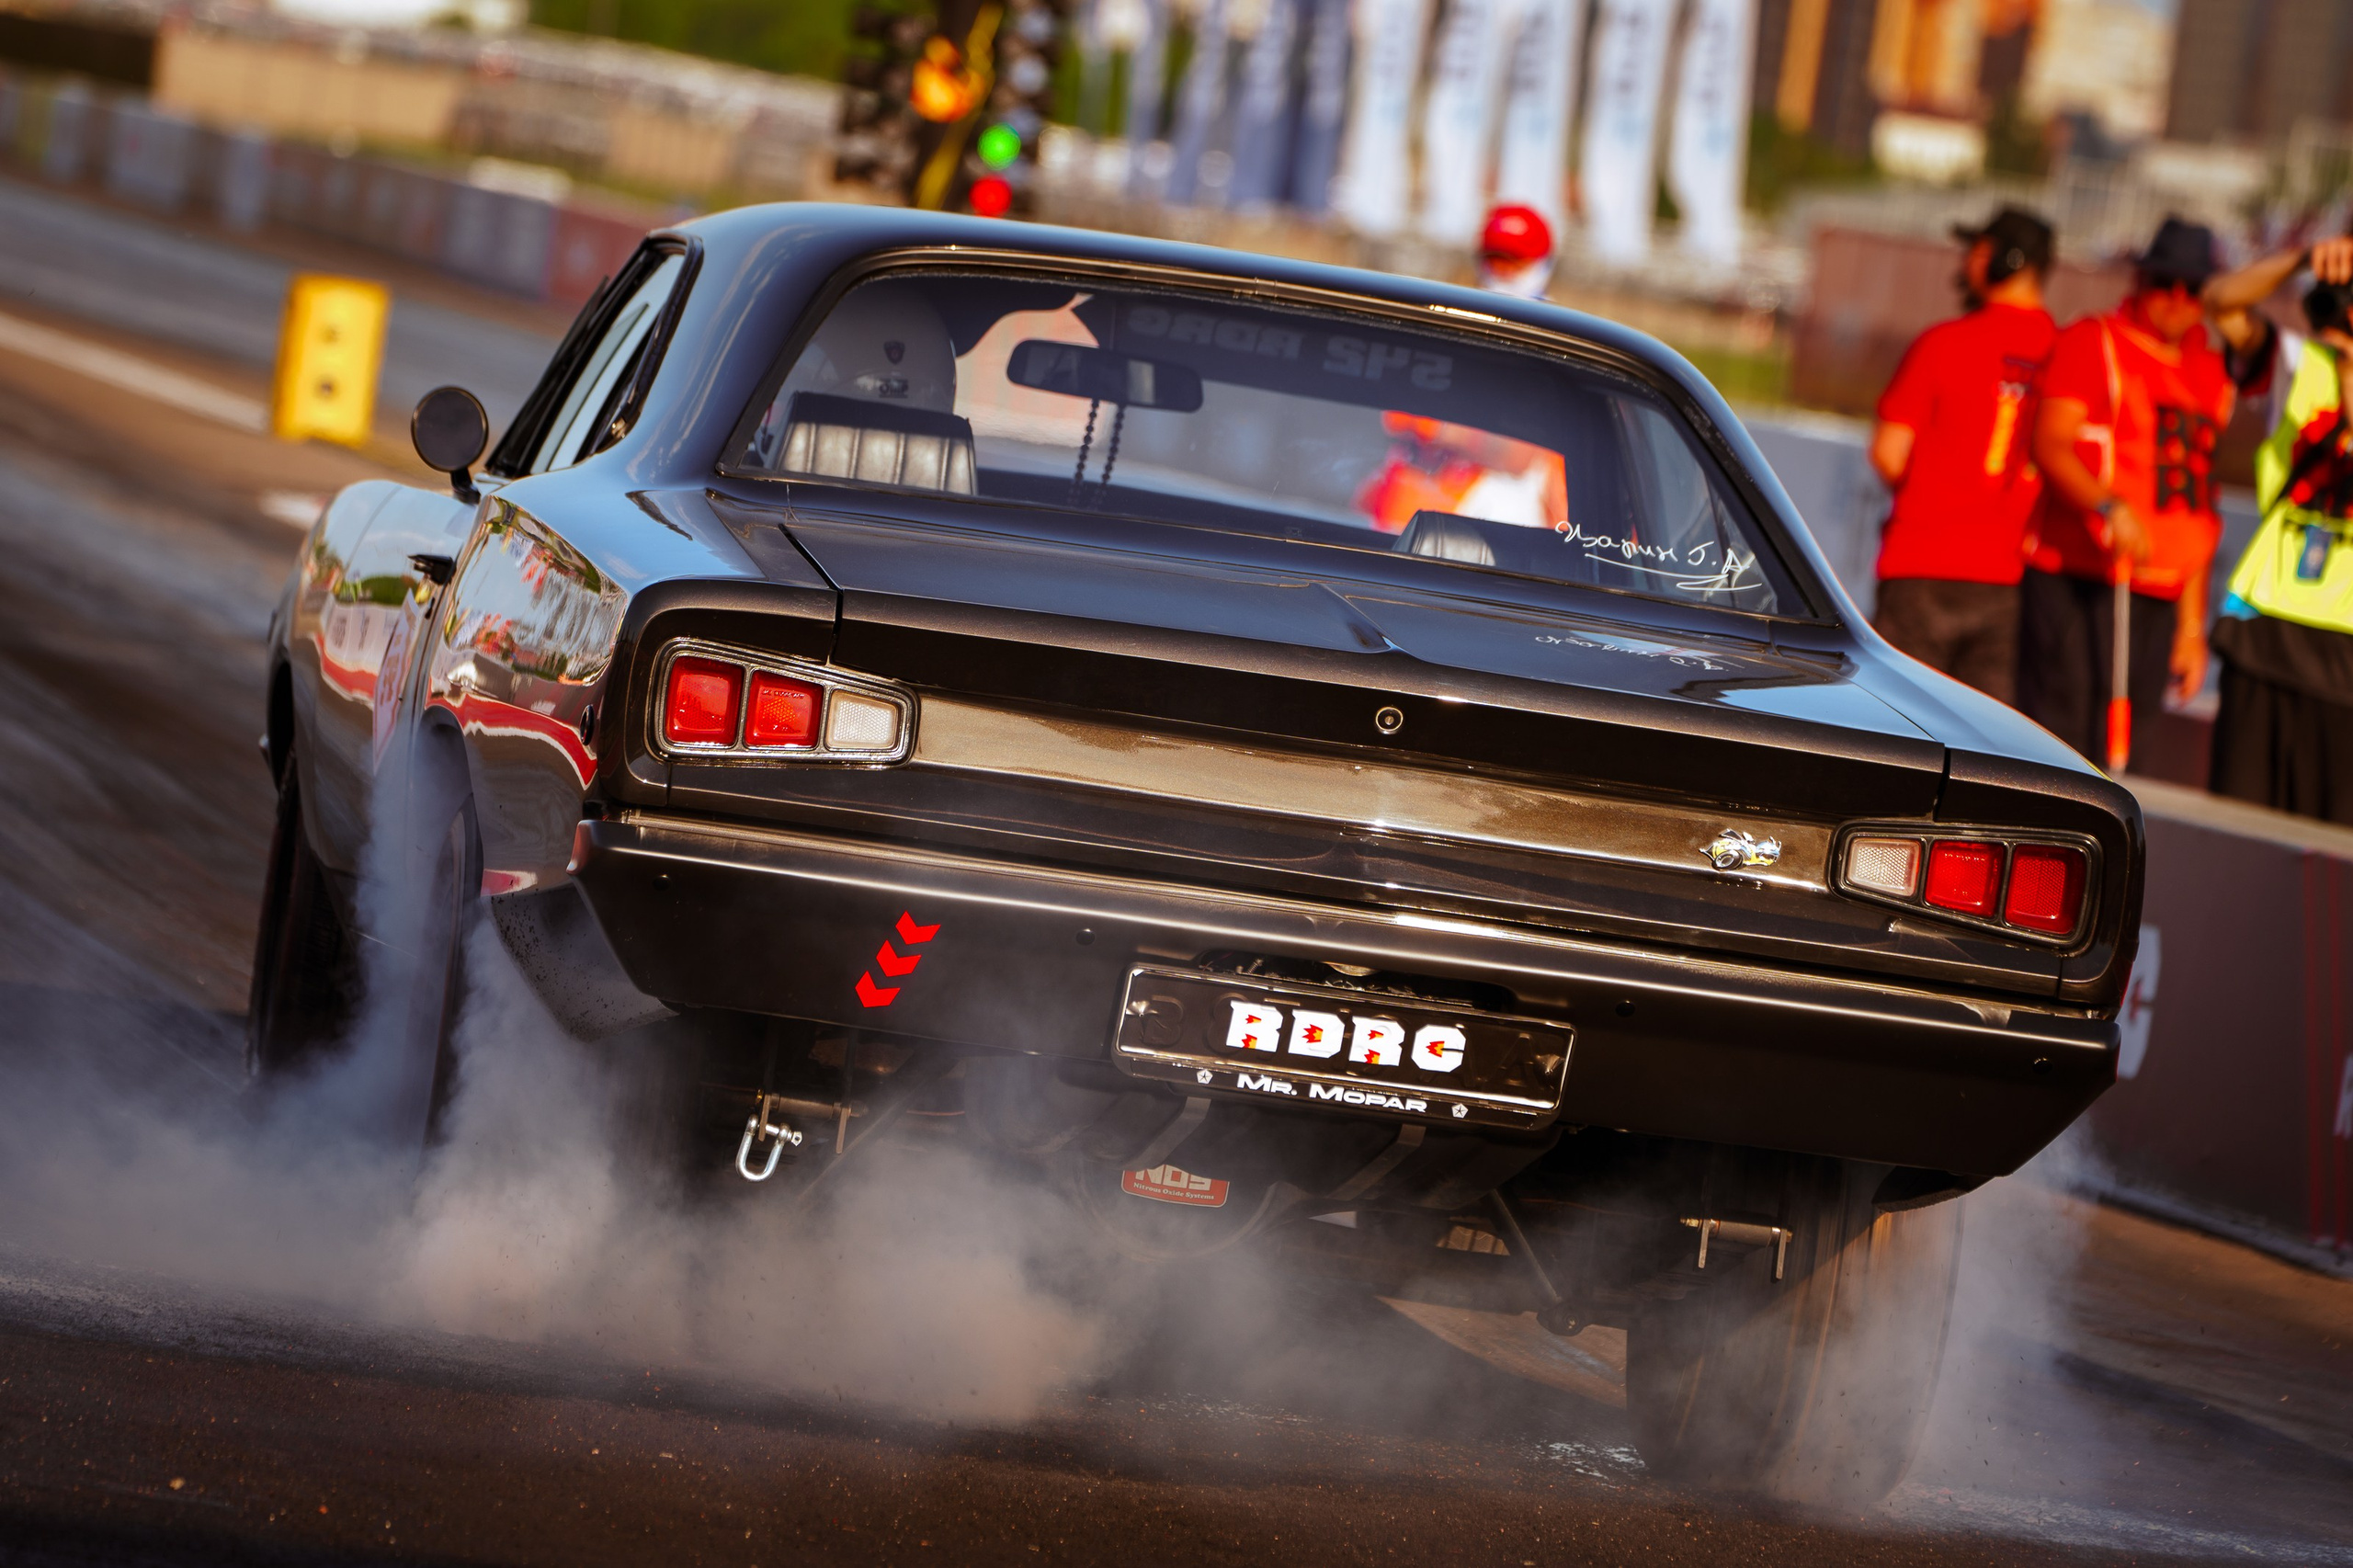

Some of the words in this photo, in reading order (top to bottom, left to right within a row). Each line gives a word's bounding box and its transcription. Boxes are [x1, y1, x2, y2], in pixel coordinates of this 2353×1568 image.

[1225, 1000, 1467, 1074] RDRC
[1308, 1083, 1428, 1113] MOPAR
[1133, 1182, 1161, 1193] Nitrous
[1163, 1187, 1185, 1198] Oxide
[1185, 1191, 1215, 1200] Systems
